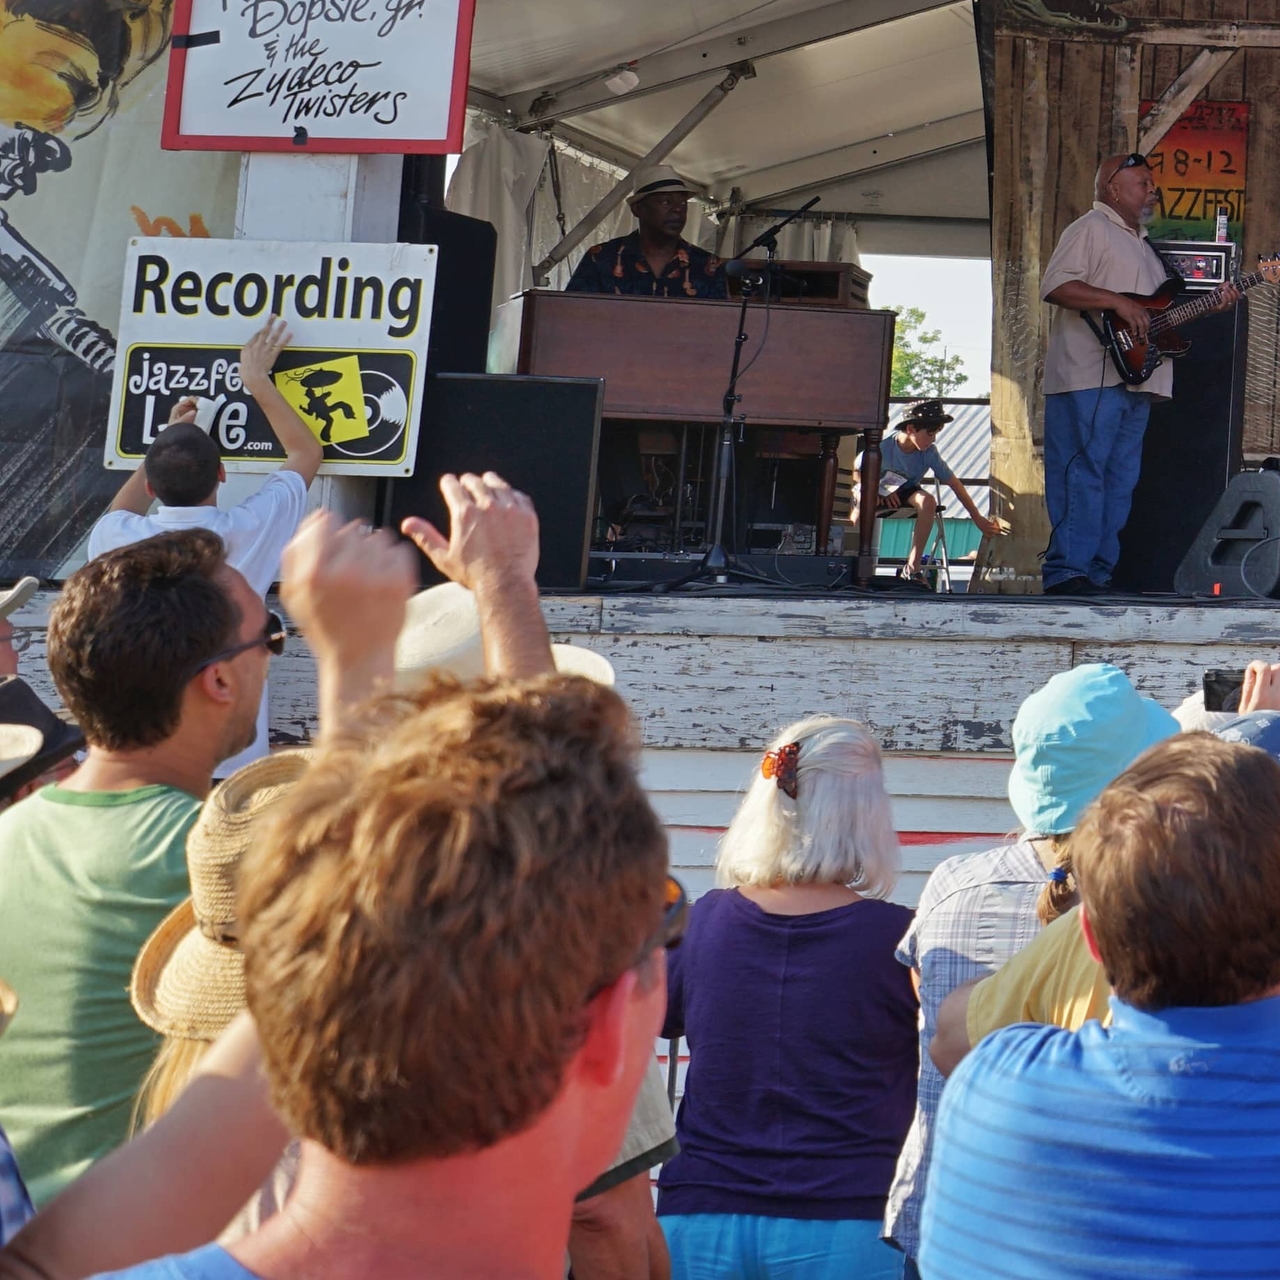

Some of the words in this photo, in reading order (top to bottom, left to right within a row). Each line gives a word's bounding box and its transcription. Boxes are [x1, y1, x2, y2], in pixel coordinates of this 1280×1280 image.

[284, 34, 329, 62] the
[223, 57, 382, 108] Zydeco
[282, 82, 407, 124] Twisters
[132, 254, 423, 339] Recording
[128, 352, 262, 397] jazzfe
[244, 440, 273, 451] .com
